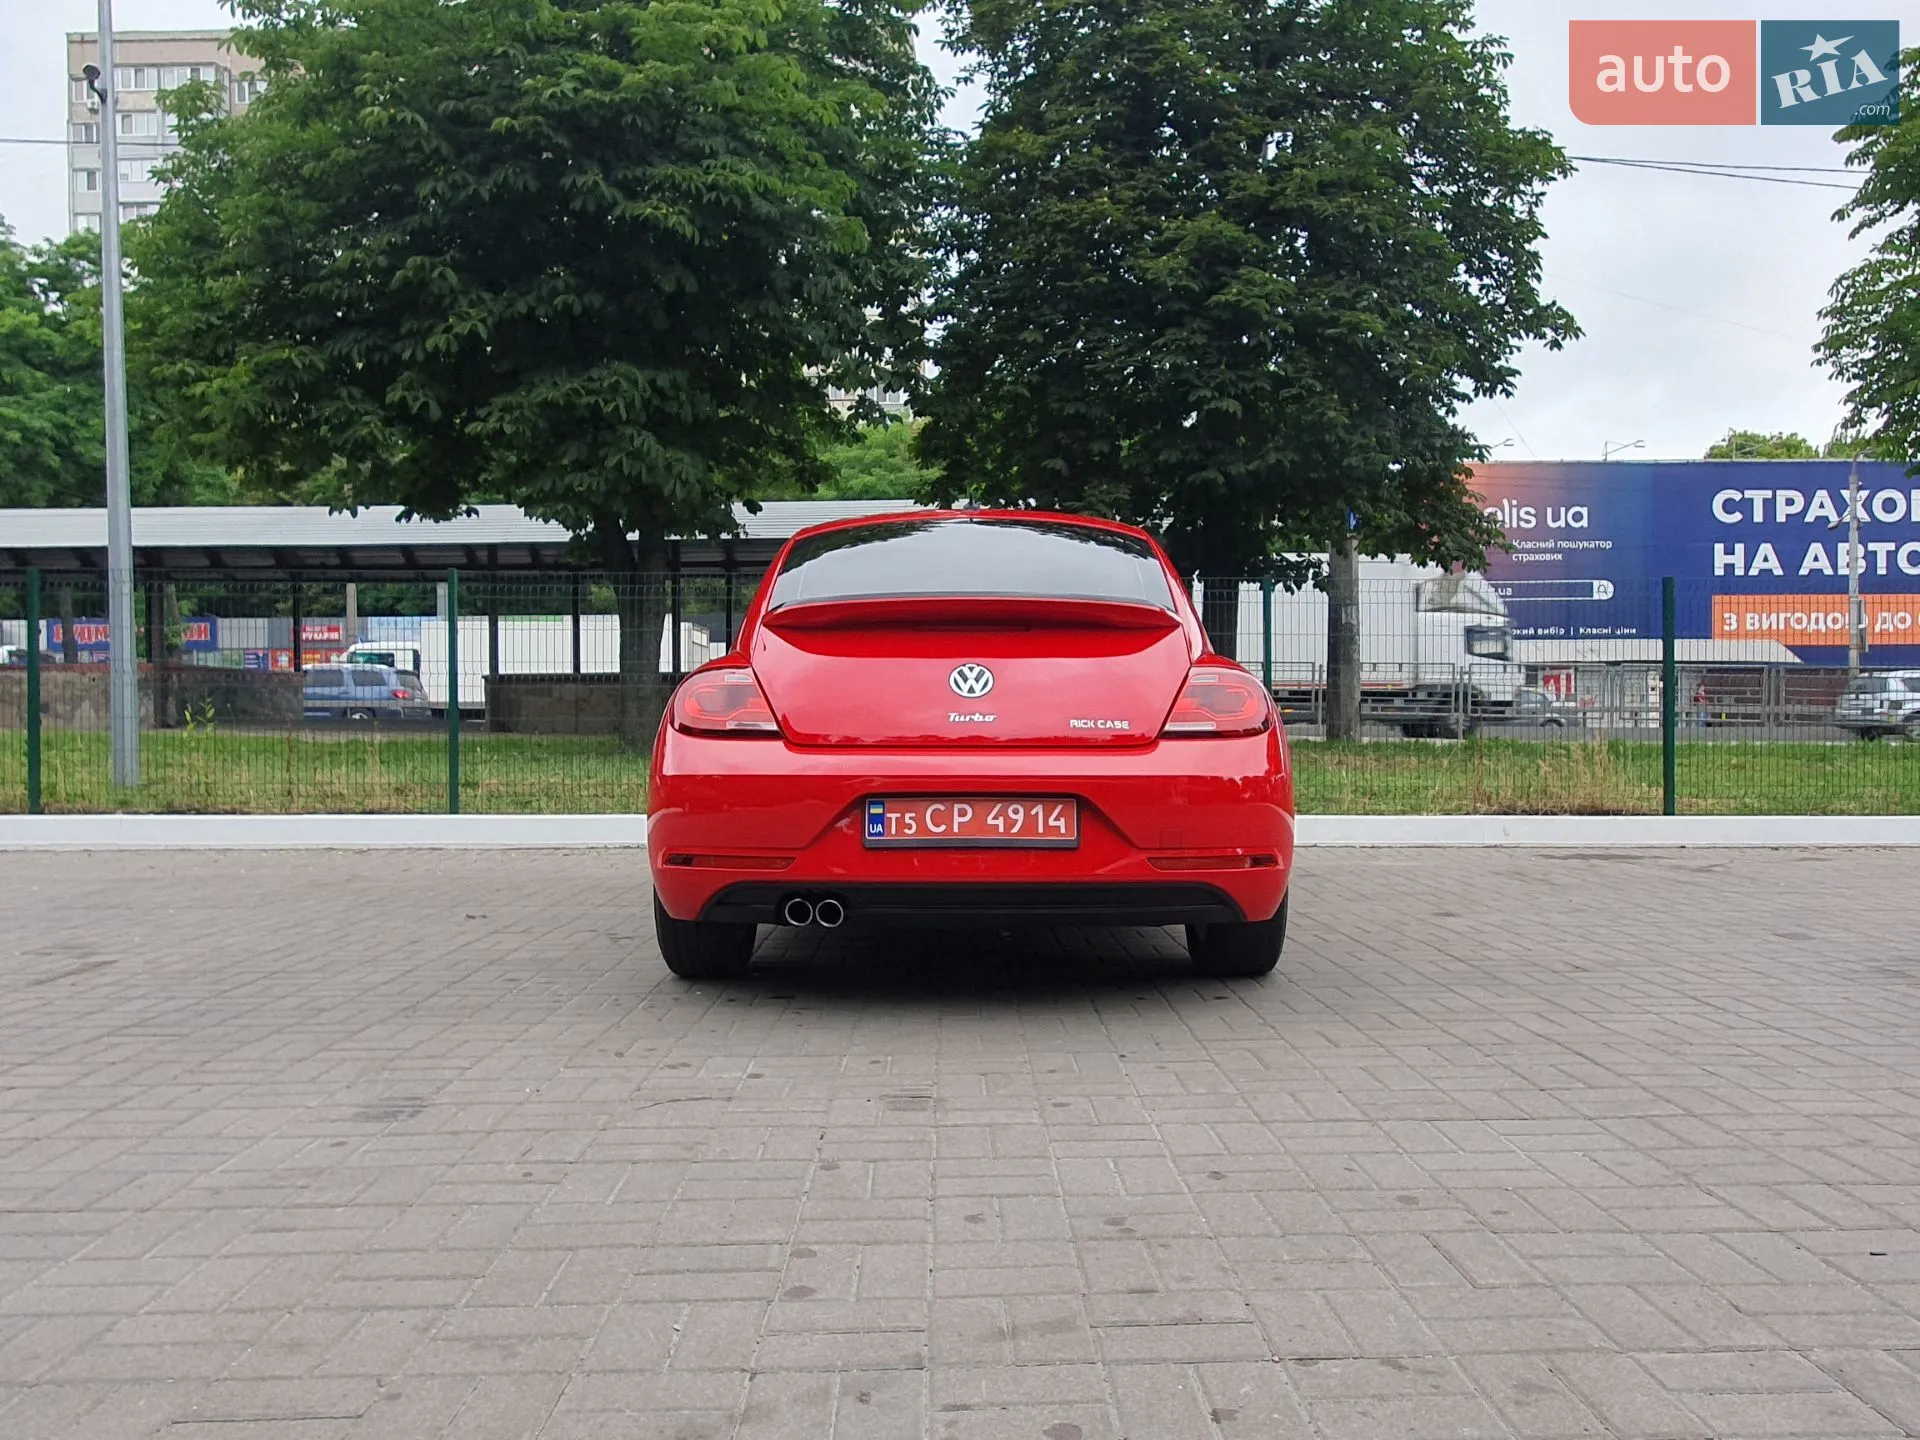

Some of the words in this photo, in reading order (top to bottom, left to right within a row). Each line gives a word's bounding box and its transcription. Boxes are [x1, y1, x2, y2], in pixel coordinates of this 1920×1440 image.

[1546, 505, 1589, 528] ua
[1512, 538, 1555, 549] Класний
[1557, 540, 1613, 550] пошукатор
[1512, 553, 1563, 563] страхових
[1714, 542, 1784, 576] НА
[1798, 542, 1920, 576] АВТО
[1874, 611, 1913, 633] ДО
[948, 711, 997, 723] Turbo
[1069, 719, 1095, 730] RICK
[1098, 719, 1130, 730] CASE
[986, 803, 1067, 834] 4914
[869, 823, 884, 834] UA
